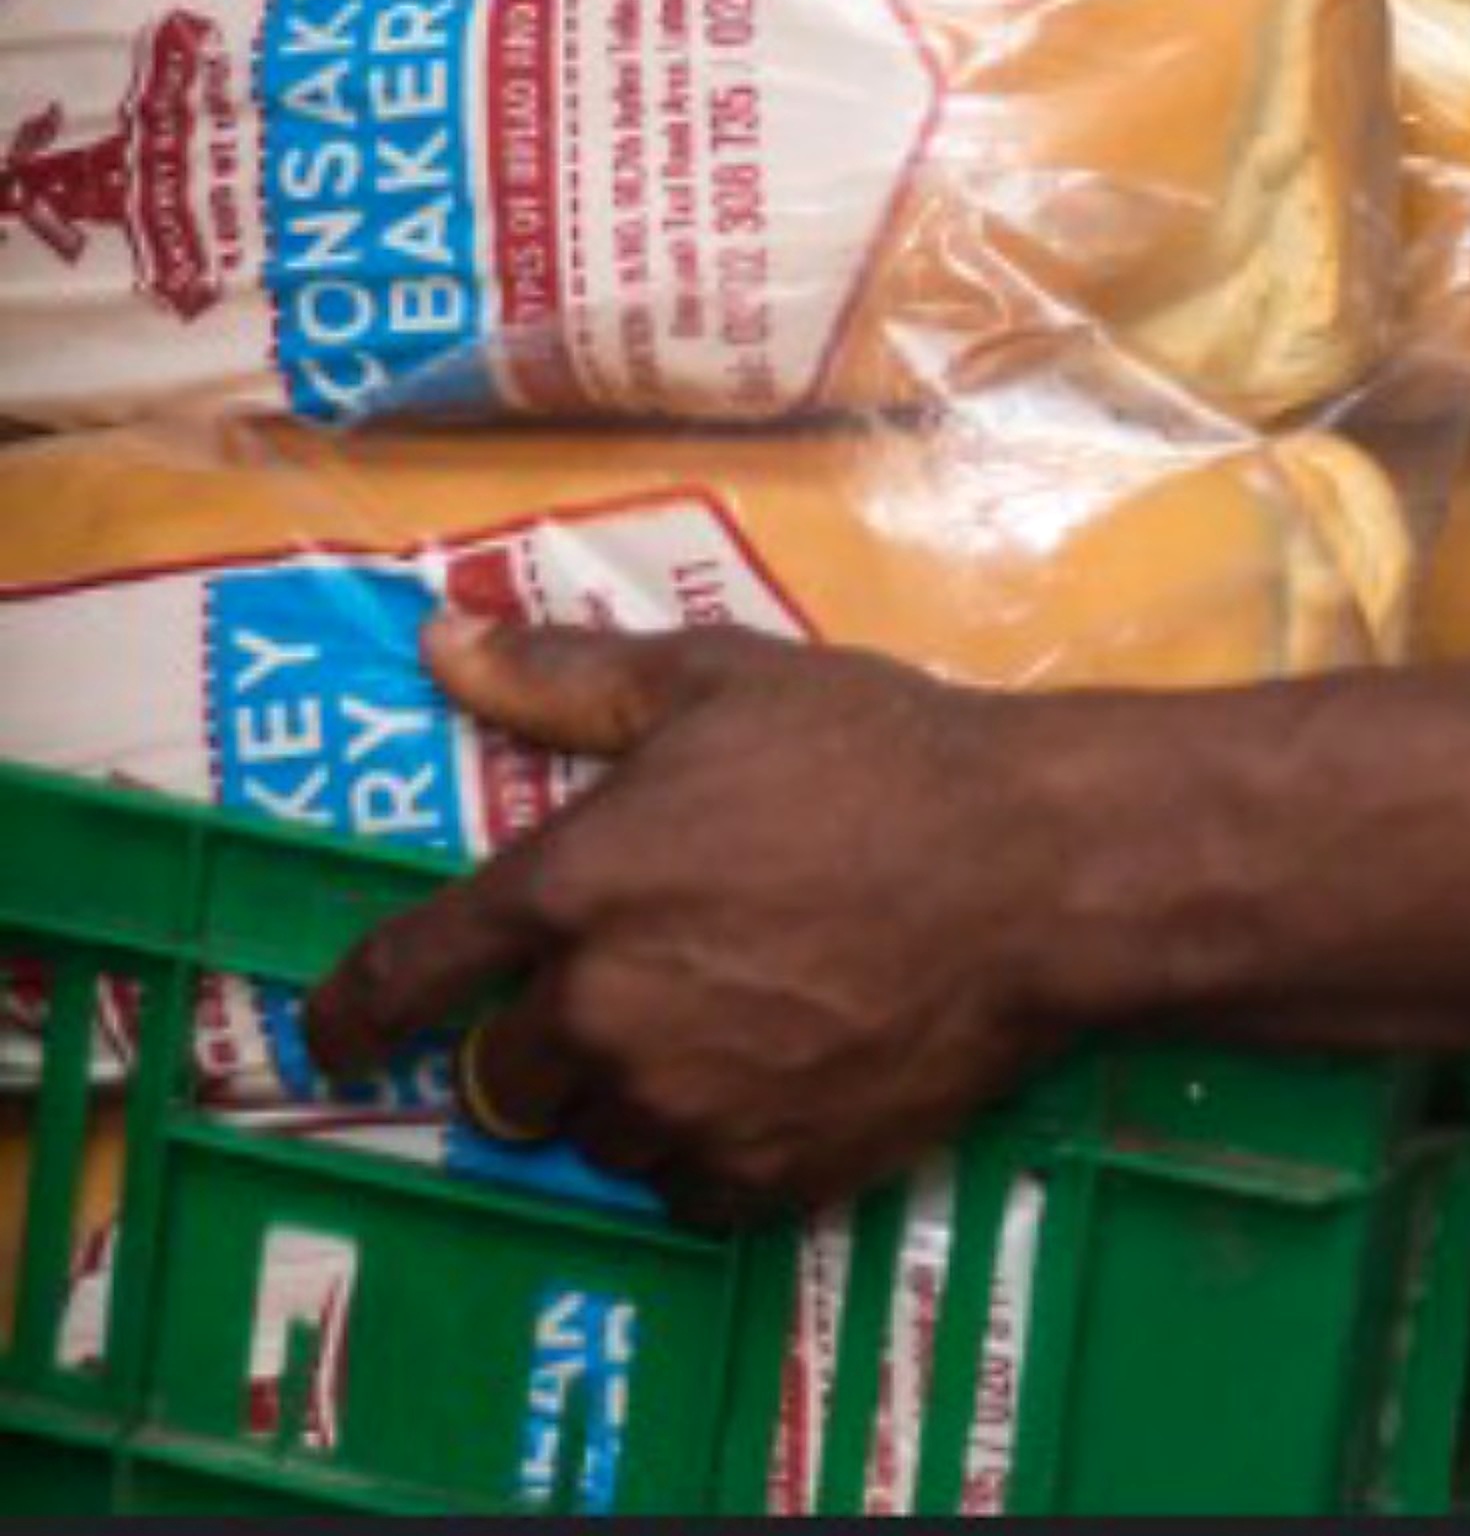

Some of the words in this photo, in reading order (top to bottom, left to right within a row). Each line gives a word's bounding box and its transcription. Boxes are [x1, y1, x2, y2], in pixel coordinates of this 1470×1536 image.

[508, 240, 548, 326] YPES
[234, 625, 333, 825] KEY
[340, 697, 442, 839] RY
